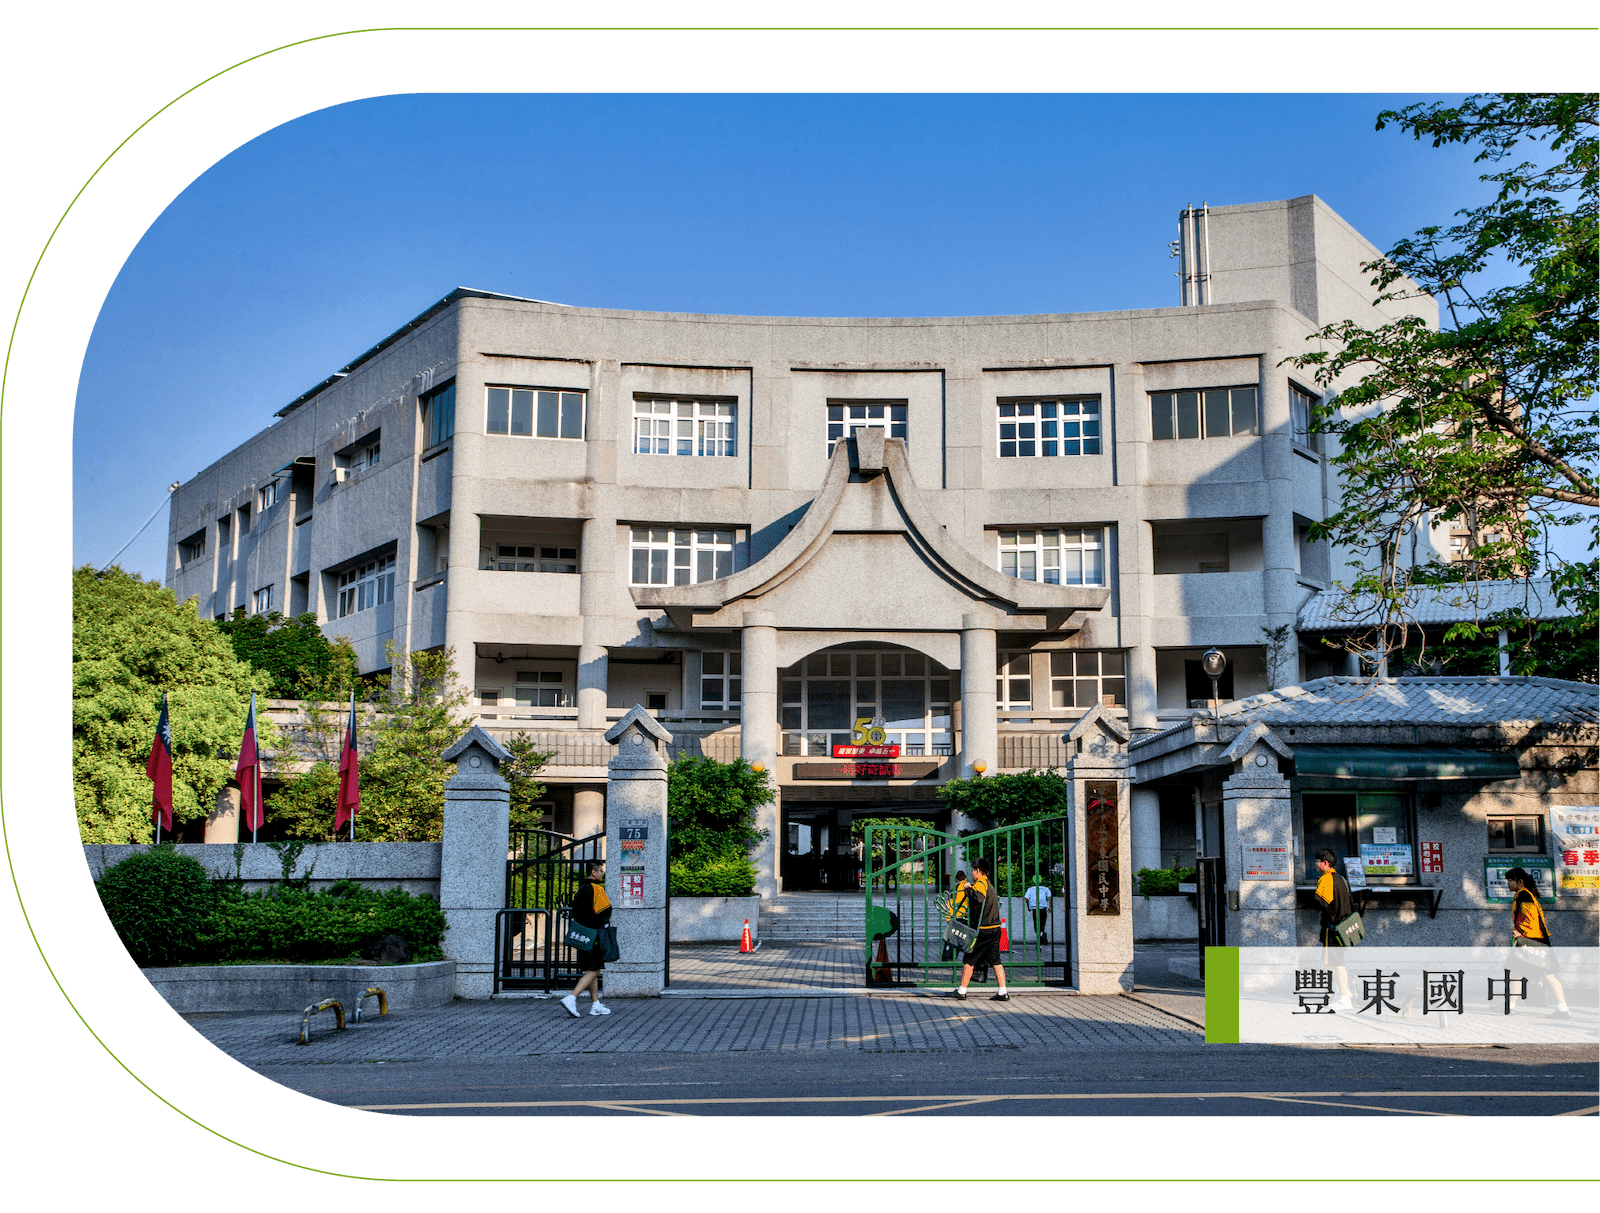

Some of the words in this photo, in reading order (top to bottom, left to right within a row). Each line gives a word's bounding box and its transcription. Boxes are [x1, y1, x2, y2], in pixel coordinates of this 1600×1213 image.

[850, 718, 886, 746] 50
[627, 828, 641, 839] 75
[1422, 843, 1431, 873] 請勿停車
[1432, 843, 1441, 873] 校門口
